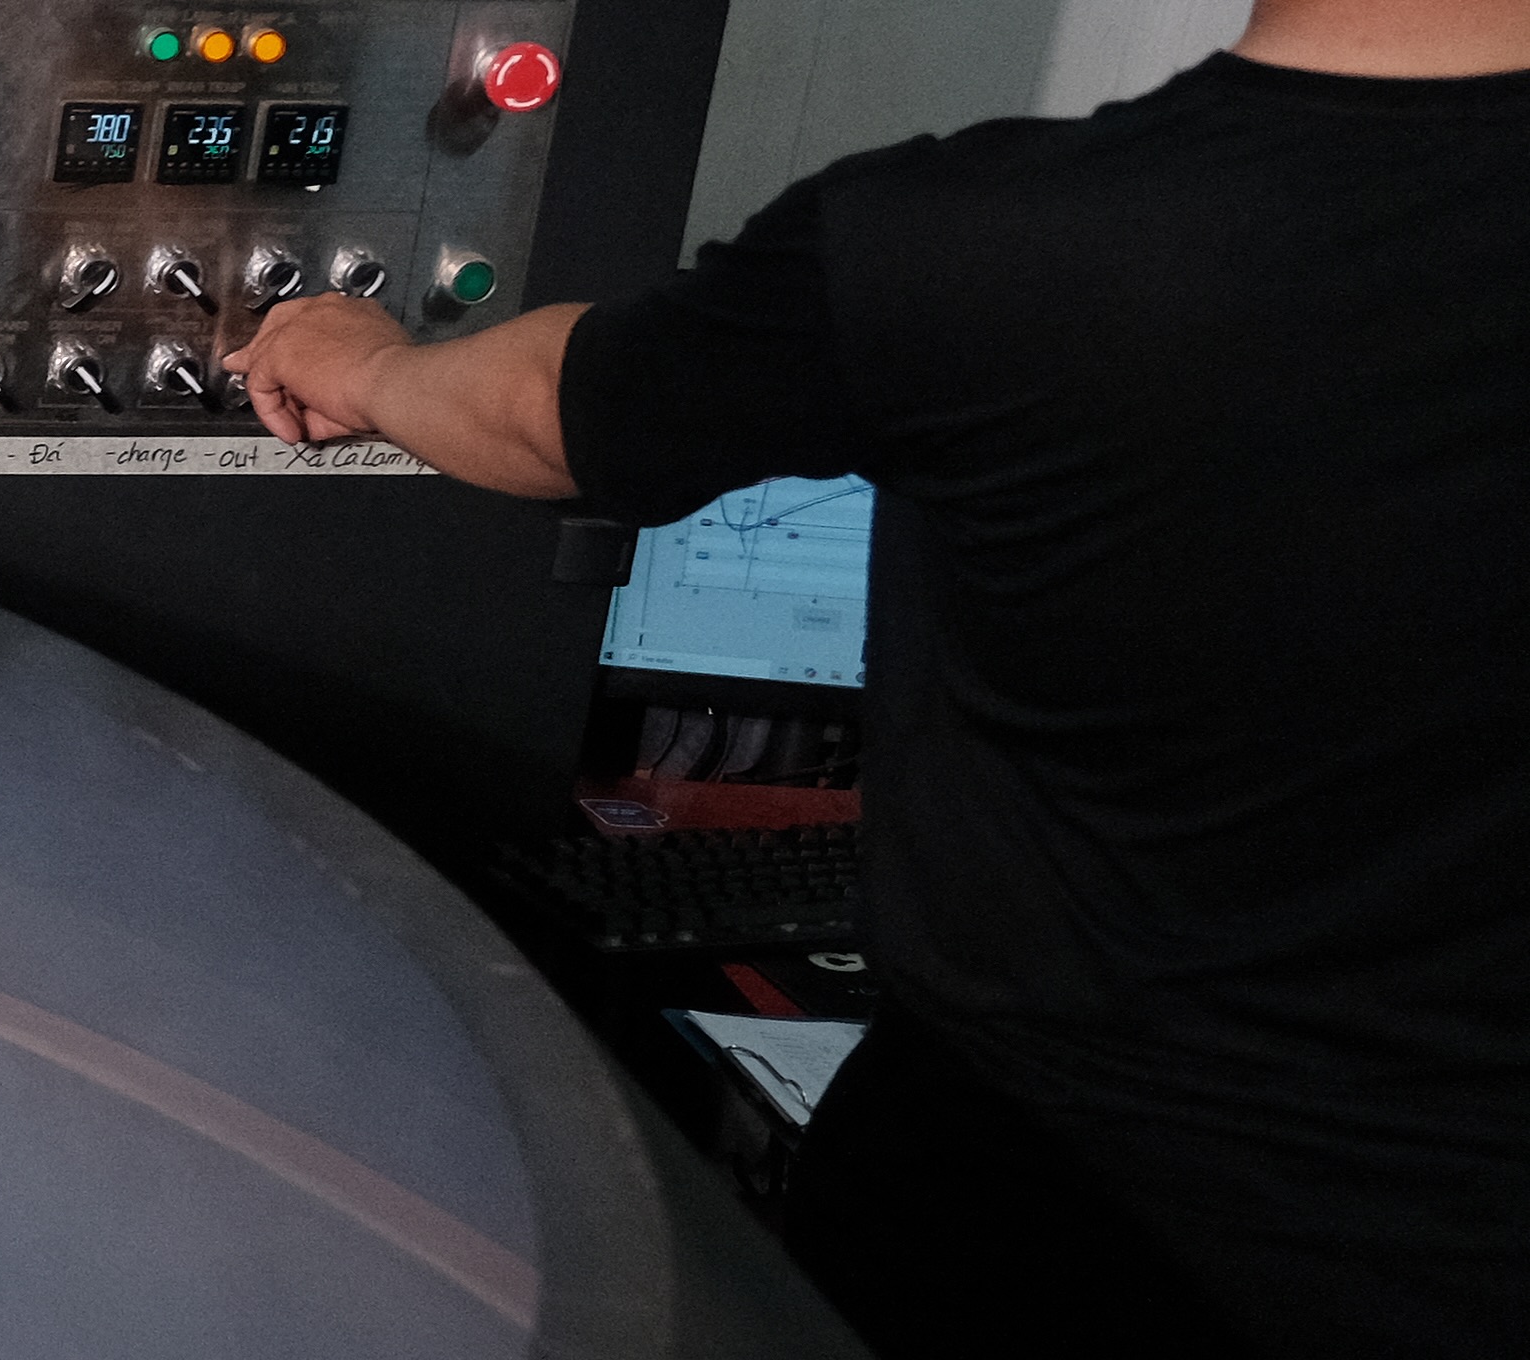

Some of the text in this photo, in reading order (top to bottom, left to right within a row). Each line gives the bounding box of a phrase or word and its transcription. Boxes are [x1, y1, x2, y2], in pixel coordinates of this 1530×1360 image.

[86, 114, 131, 142] 380
[188, 116, 233, 144] 235
[29, 441, 65, 464] Đá
